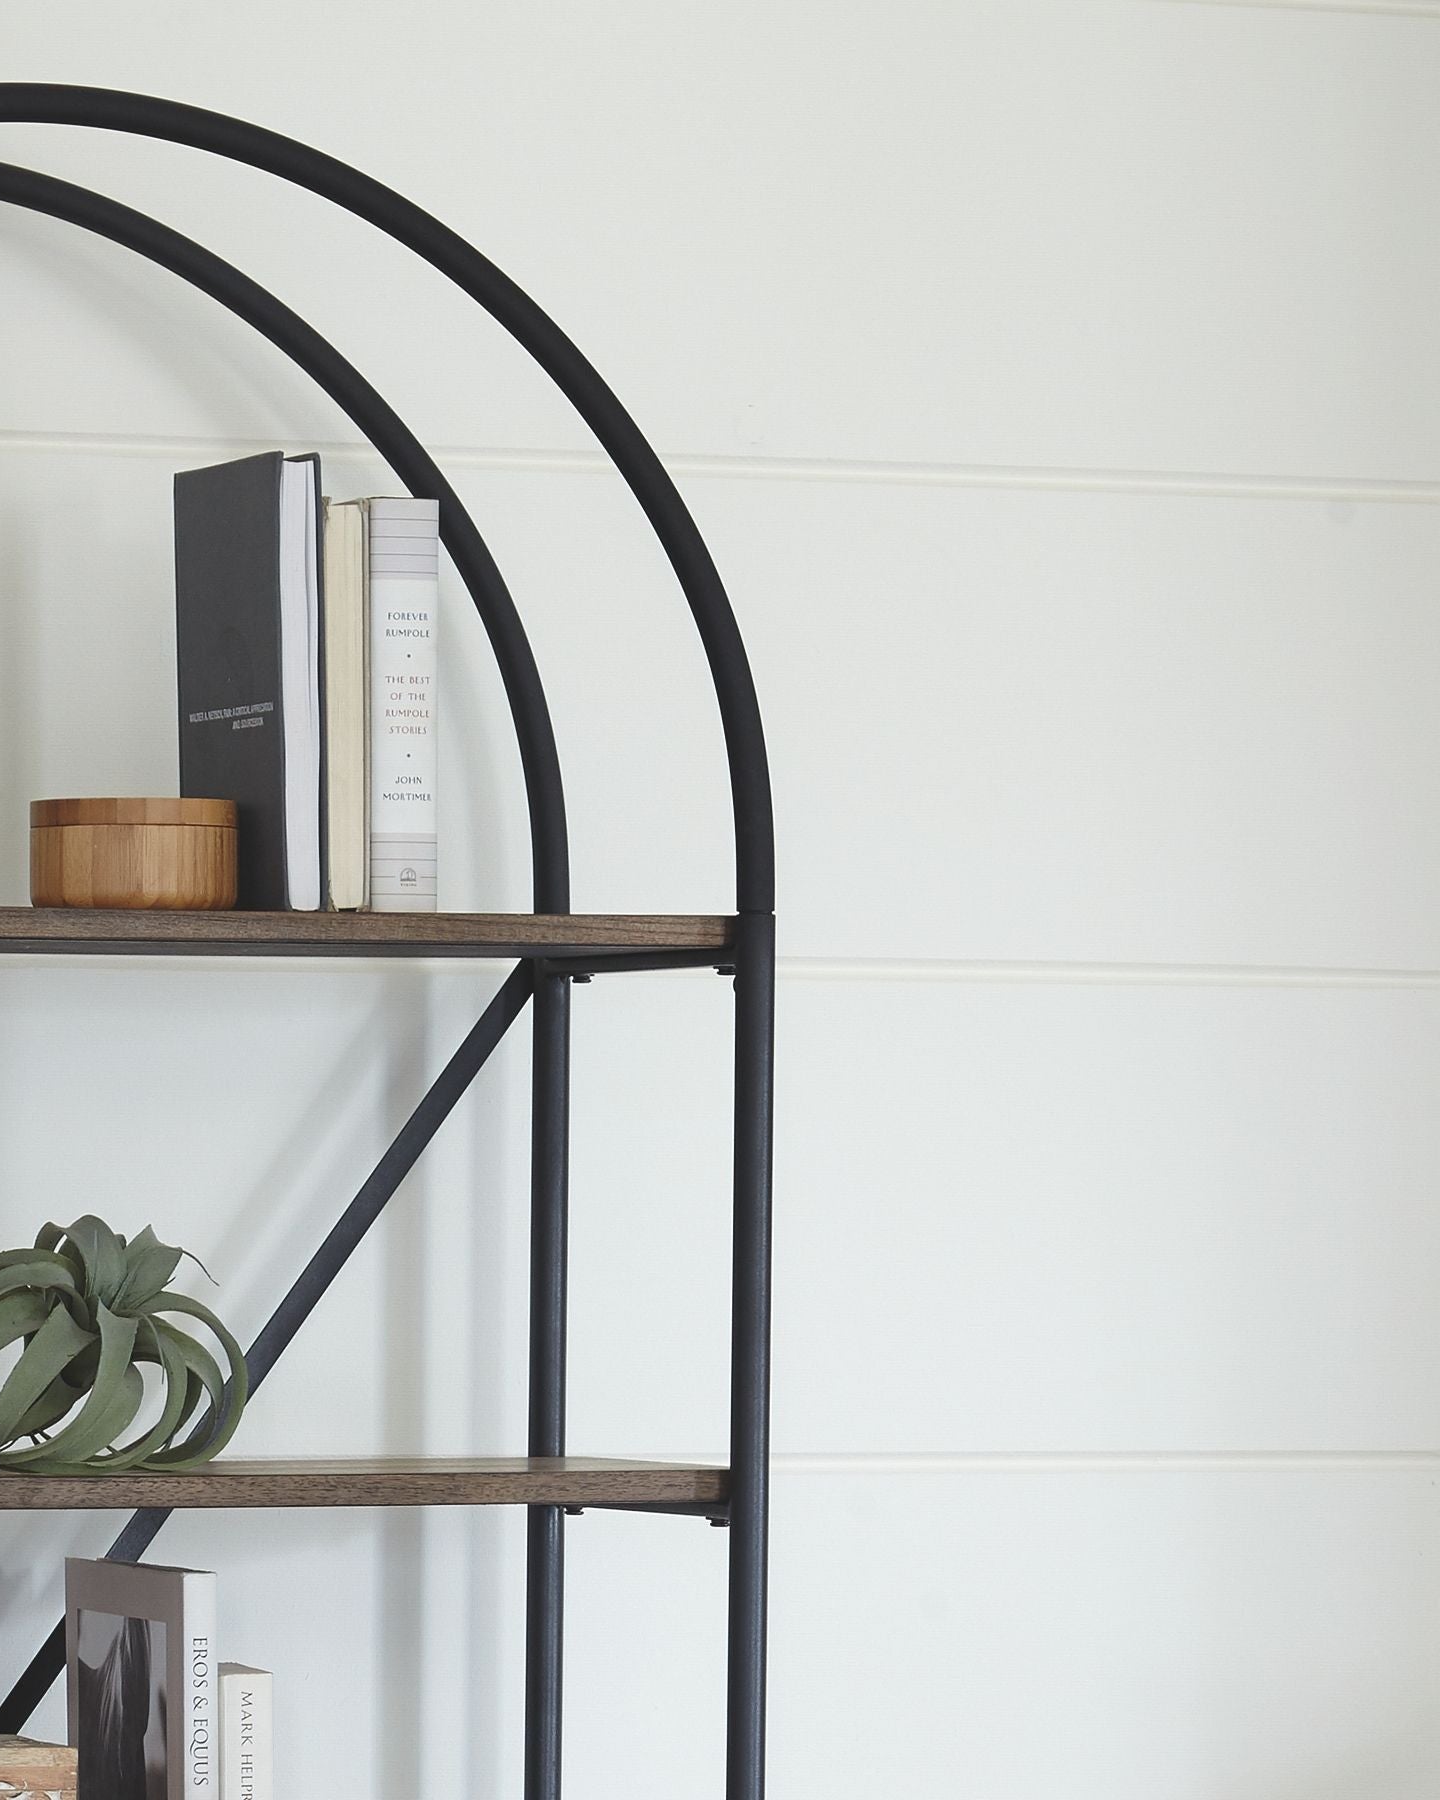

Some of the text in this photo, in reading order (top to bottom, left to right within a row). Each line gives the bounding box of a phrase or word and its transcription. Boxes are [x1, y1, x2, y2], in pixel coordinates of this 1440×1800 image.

[387, 612, 429, 621] FOREVER
[385, 628, 430, 638] RUMPOLE
[384, 675, 430, 685] THE BEST
[390, 692, 427, 701] OF THE
[385, 709, 430, 718] RUMPOLE
[389, 725, 427, 735] STORIES
[394, 776, 423, 785] JOHN
[382, 792, 432, 802] MORTIMER
[189, 1637, 209, 1786] EROS & EQUUS
[240, 1691, 254, 1746] MARK
